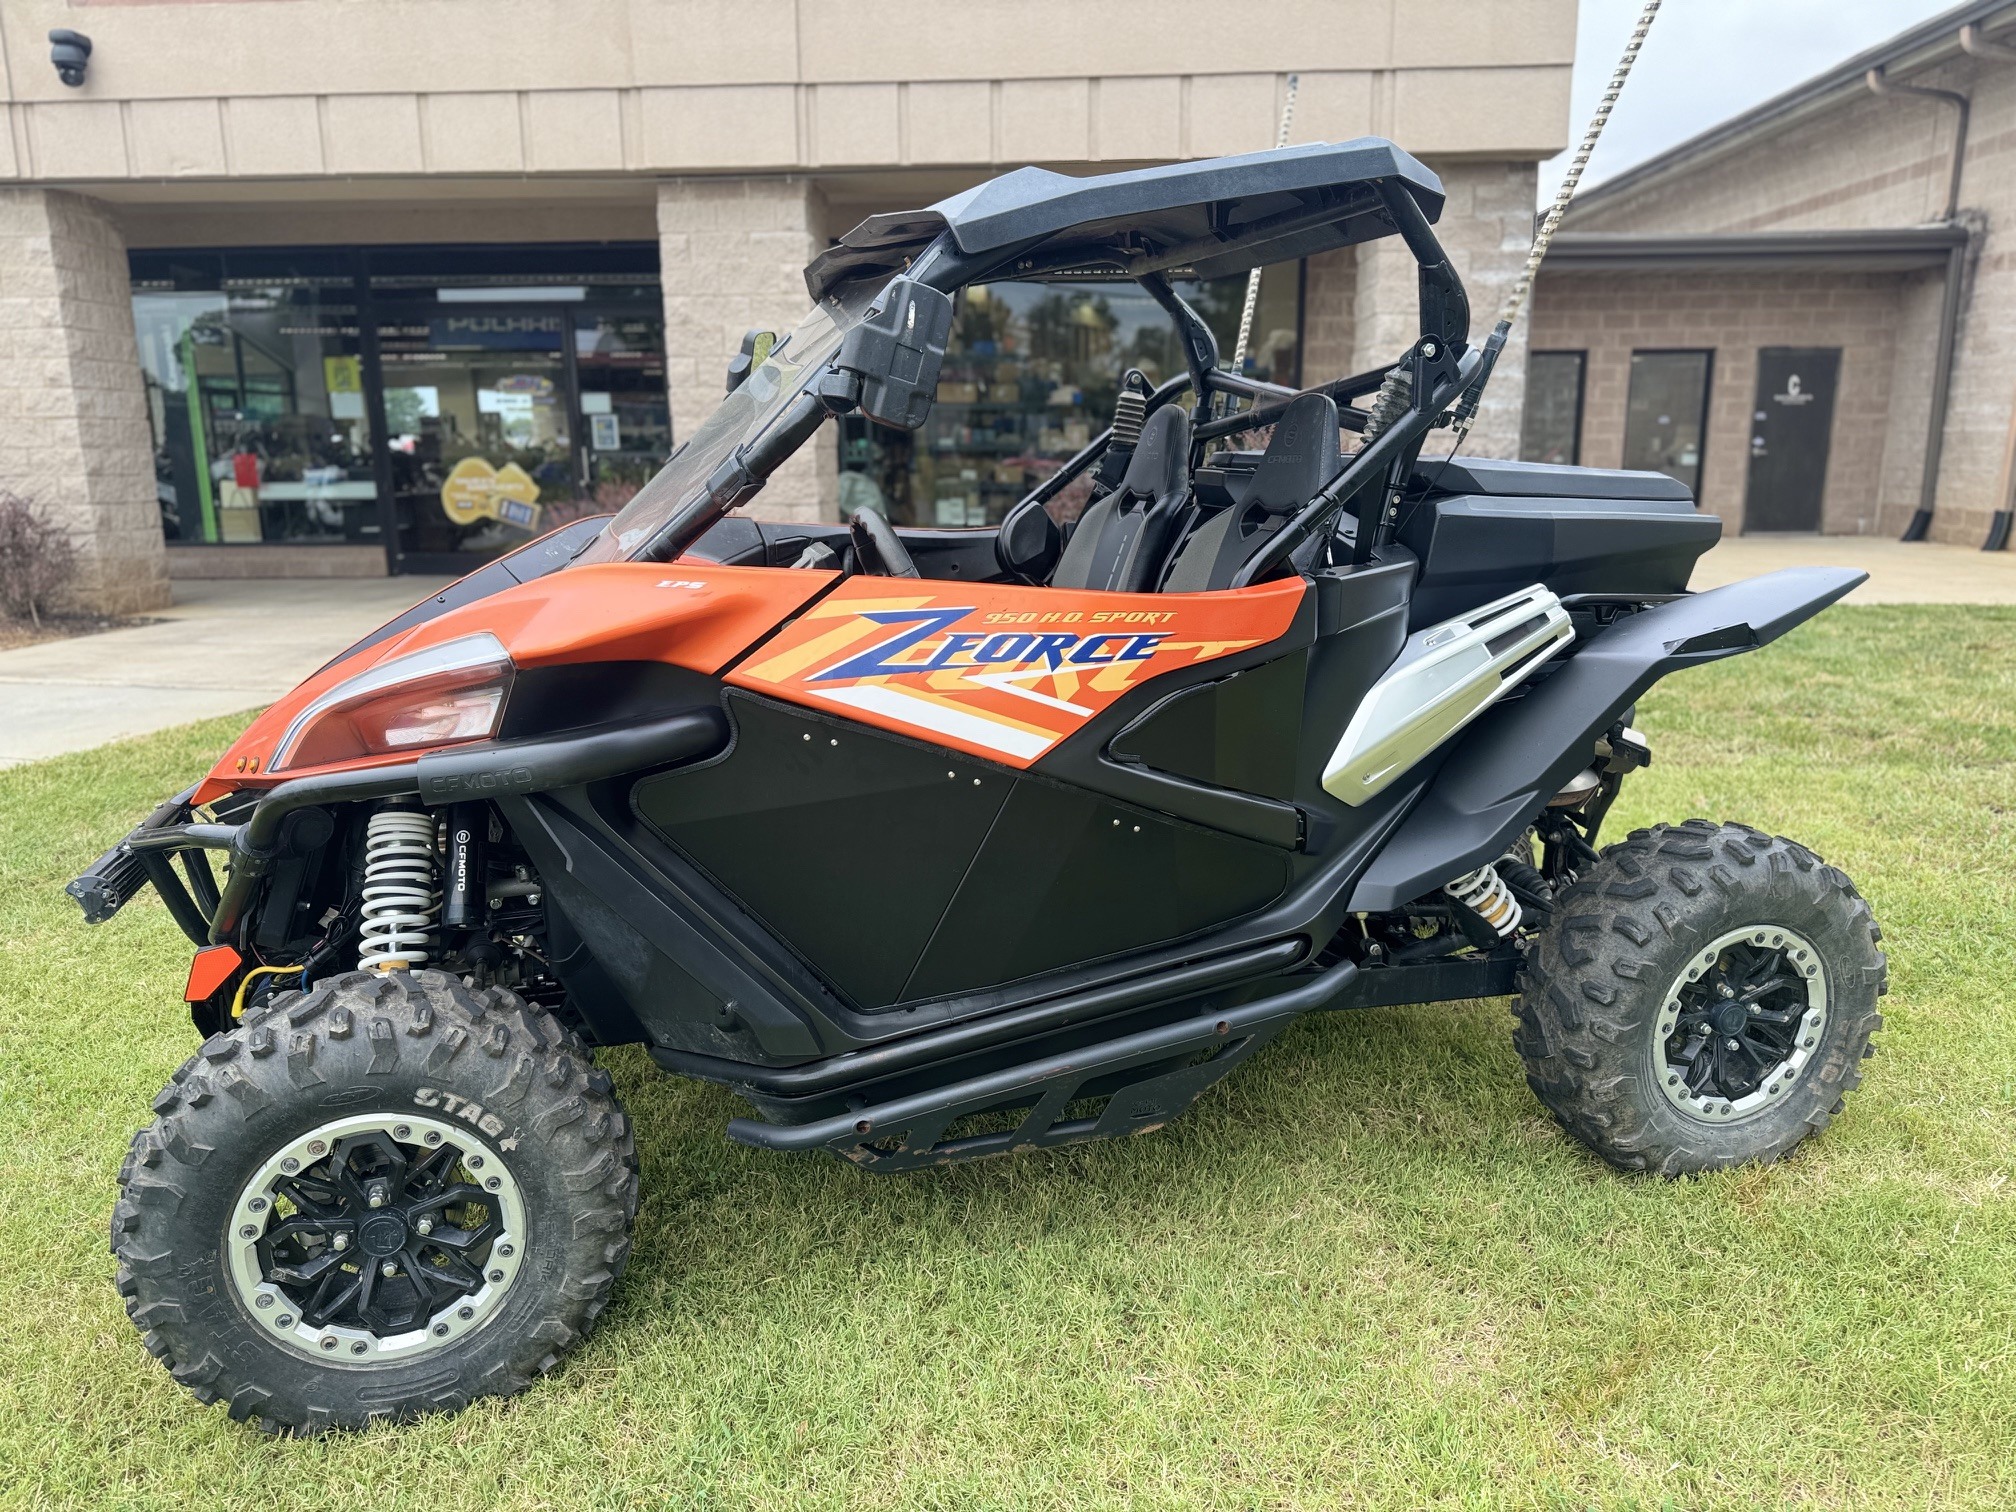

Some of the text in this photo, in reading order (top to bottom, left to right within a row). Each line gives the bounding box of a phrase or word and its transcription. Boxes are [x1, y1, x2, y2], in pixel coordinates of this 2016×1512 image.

[655, 579, 708, 590] EPS
[982, 611, 1038, 625] 950
[1089, 611, 1179, 625] SPORT
[429, 767, 533, 793] CFMOTO
[457, 845, 468, 893] CFMOTO
[412, 1086, 505, 1138] STAG
